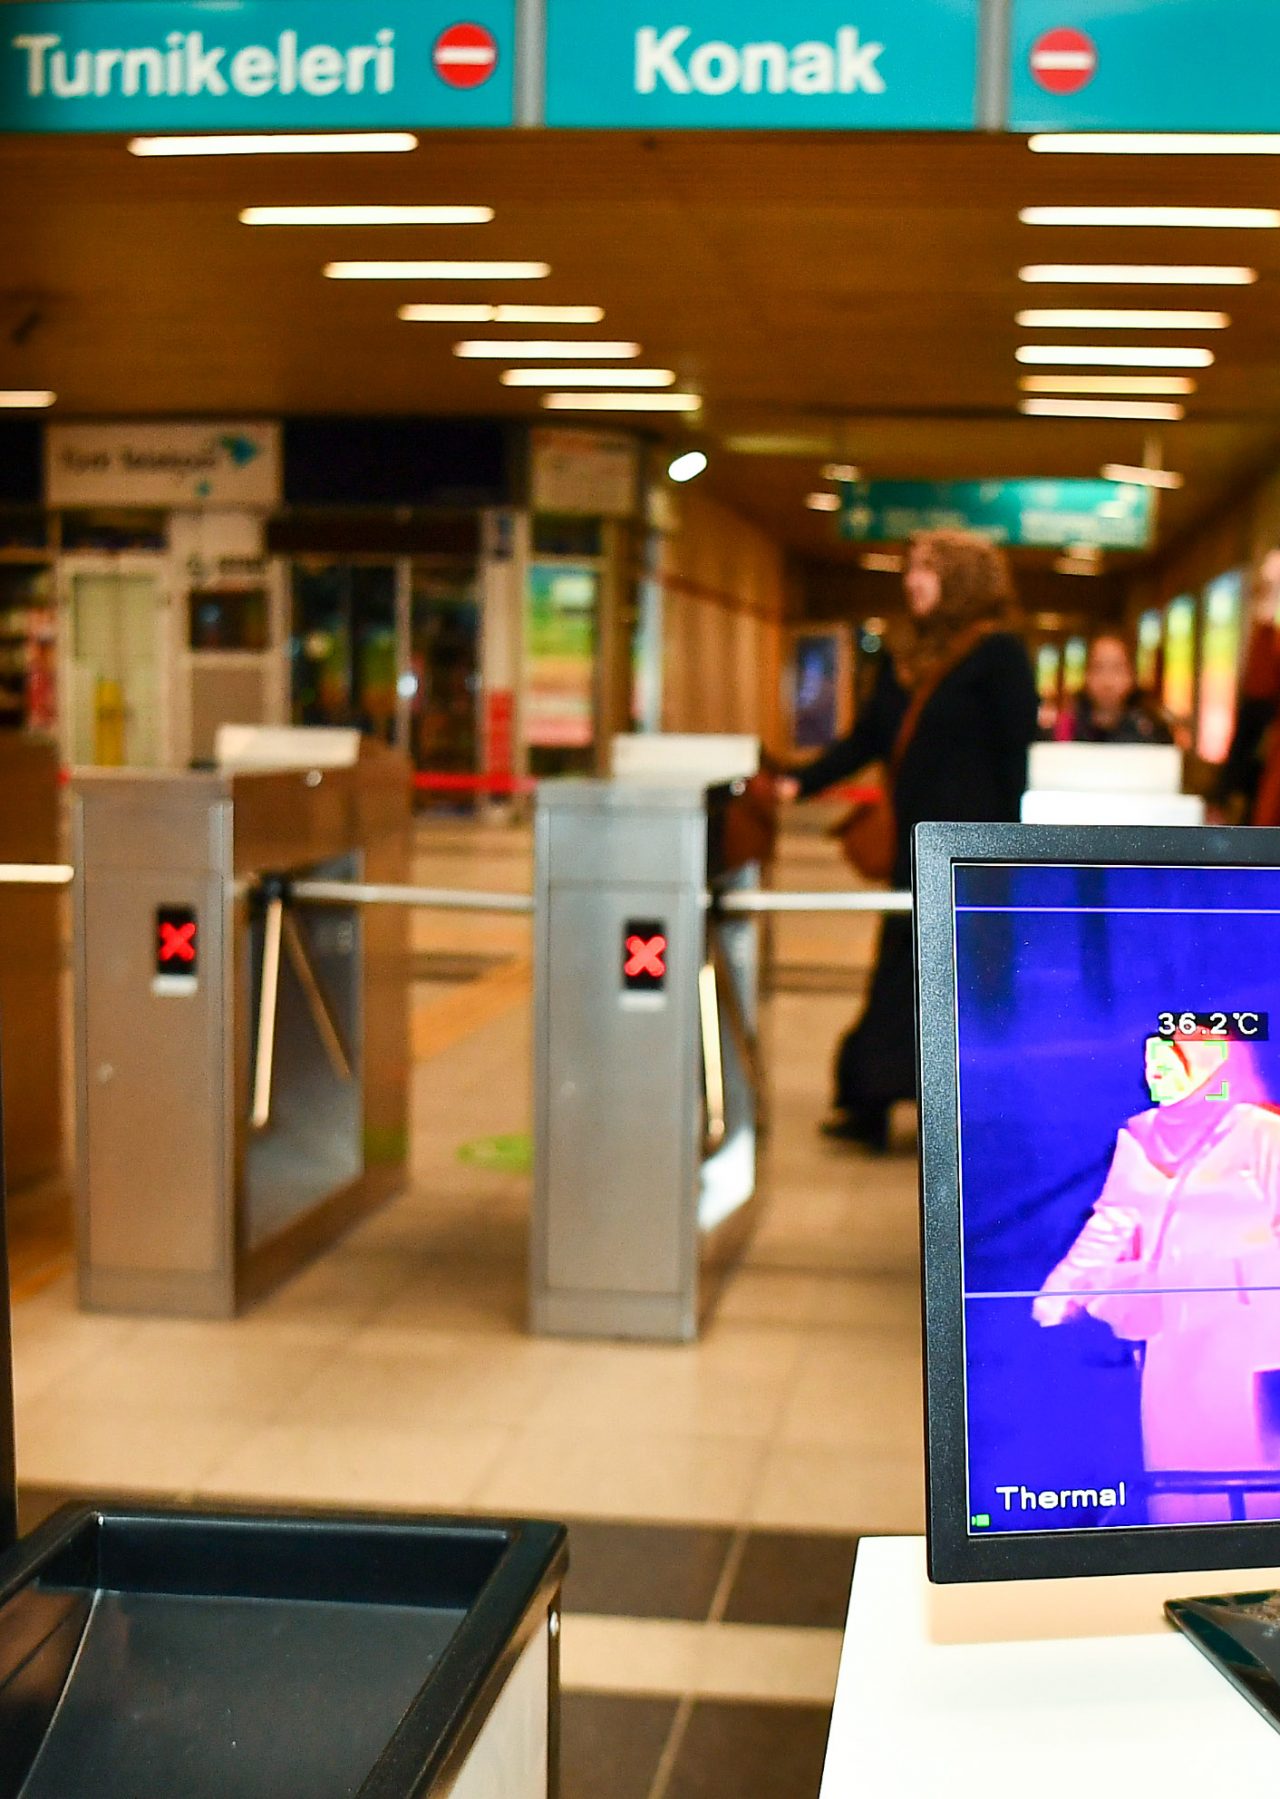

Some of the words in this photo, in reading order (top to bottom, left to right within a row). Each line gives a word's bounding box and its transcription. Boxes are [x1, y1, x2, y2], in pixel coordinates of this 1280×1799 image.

[12, 28, 396, 98] Turnikeleri
[634, 24, 887, 95] Konak
[996, 1482, 1126, 1511] Thermal
